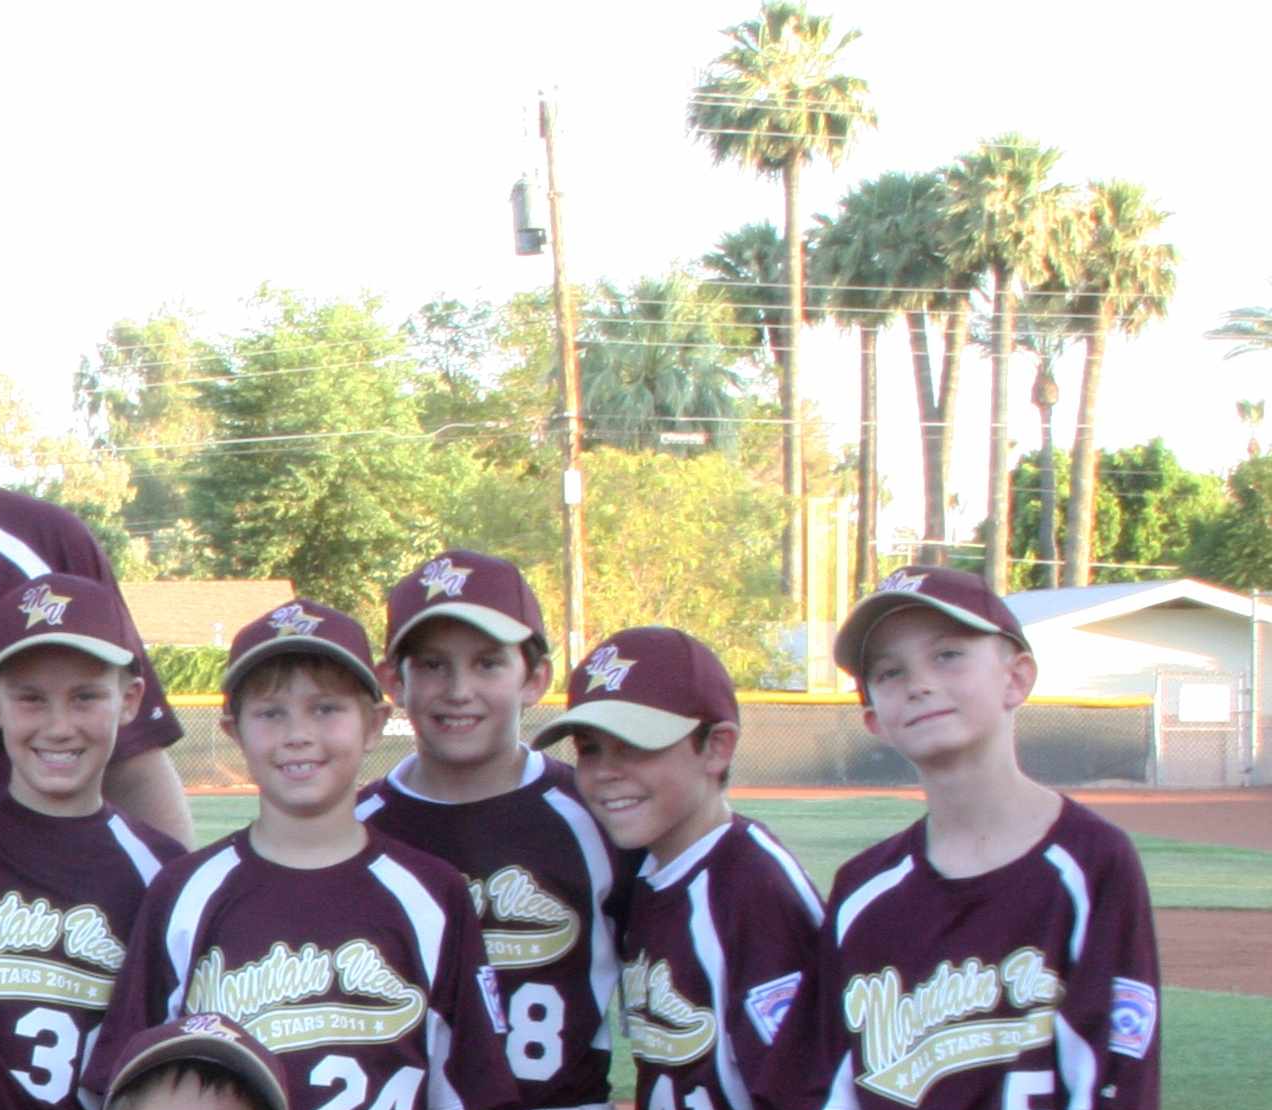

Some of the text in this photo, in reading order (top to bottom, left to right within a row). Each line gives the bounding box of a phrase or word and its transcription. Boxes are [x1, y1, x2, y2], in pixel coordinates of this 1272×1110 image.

[47, 971, 81, 993] 2011
[335, 943, 407, 999] View
[271, 1013, 325, 1038] STARS
[330, 1014, 366, 1032] 2011
[908, 1054, 934, 1084] ALL
[933, 1032, 993, 1060] STARS
